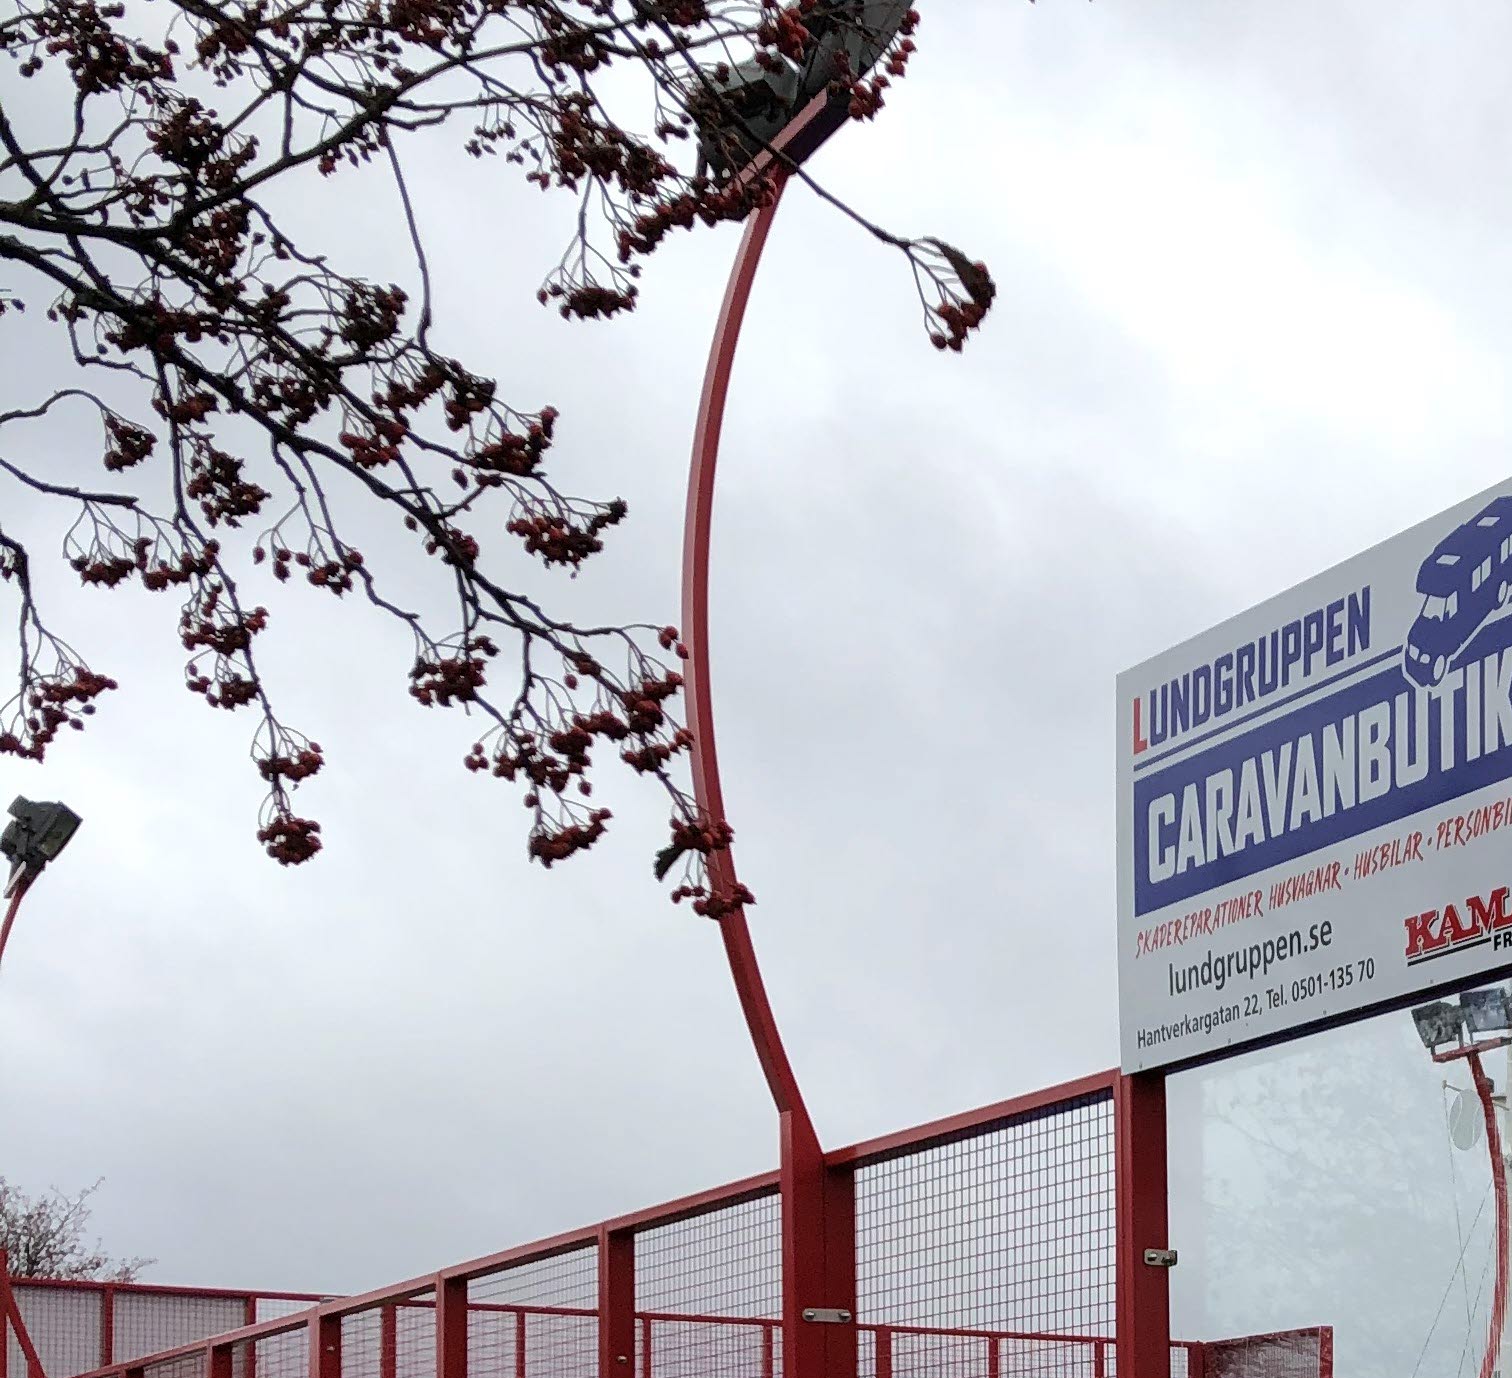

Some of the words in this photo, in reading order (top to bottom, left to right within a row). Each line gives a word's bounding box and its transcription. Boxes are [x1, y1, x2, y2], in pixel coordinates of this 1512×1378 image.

[1133, 585, 1371, 755] LUNDGRUPPEN
[1136, 889, 1264, 959] SKADEREPARATIONER
[1268, 861, 1342, 910] HUSVAGNAR
[1353, 831, 1424, 880] HUSBILAR
[1136, 1003, 1240, 1049] Hantverkargatan
[1243, 993, 1263, 1017] 22,
[1266, 984, 1288, 1010] Tel.
[1291, 963, 1354, 1003] 0501-135
[1357, 957, 1376, 982] 70
[1168, 919, 1333, 997] lundgruppen.se
